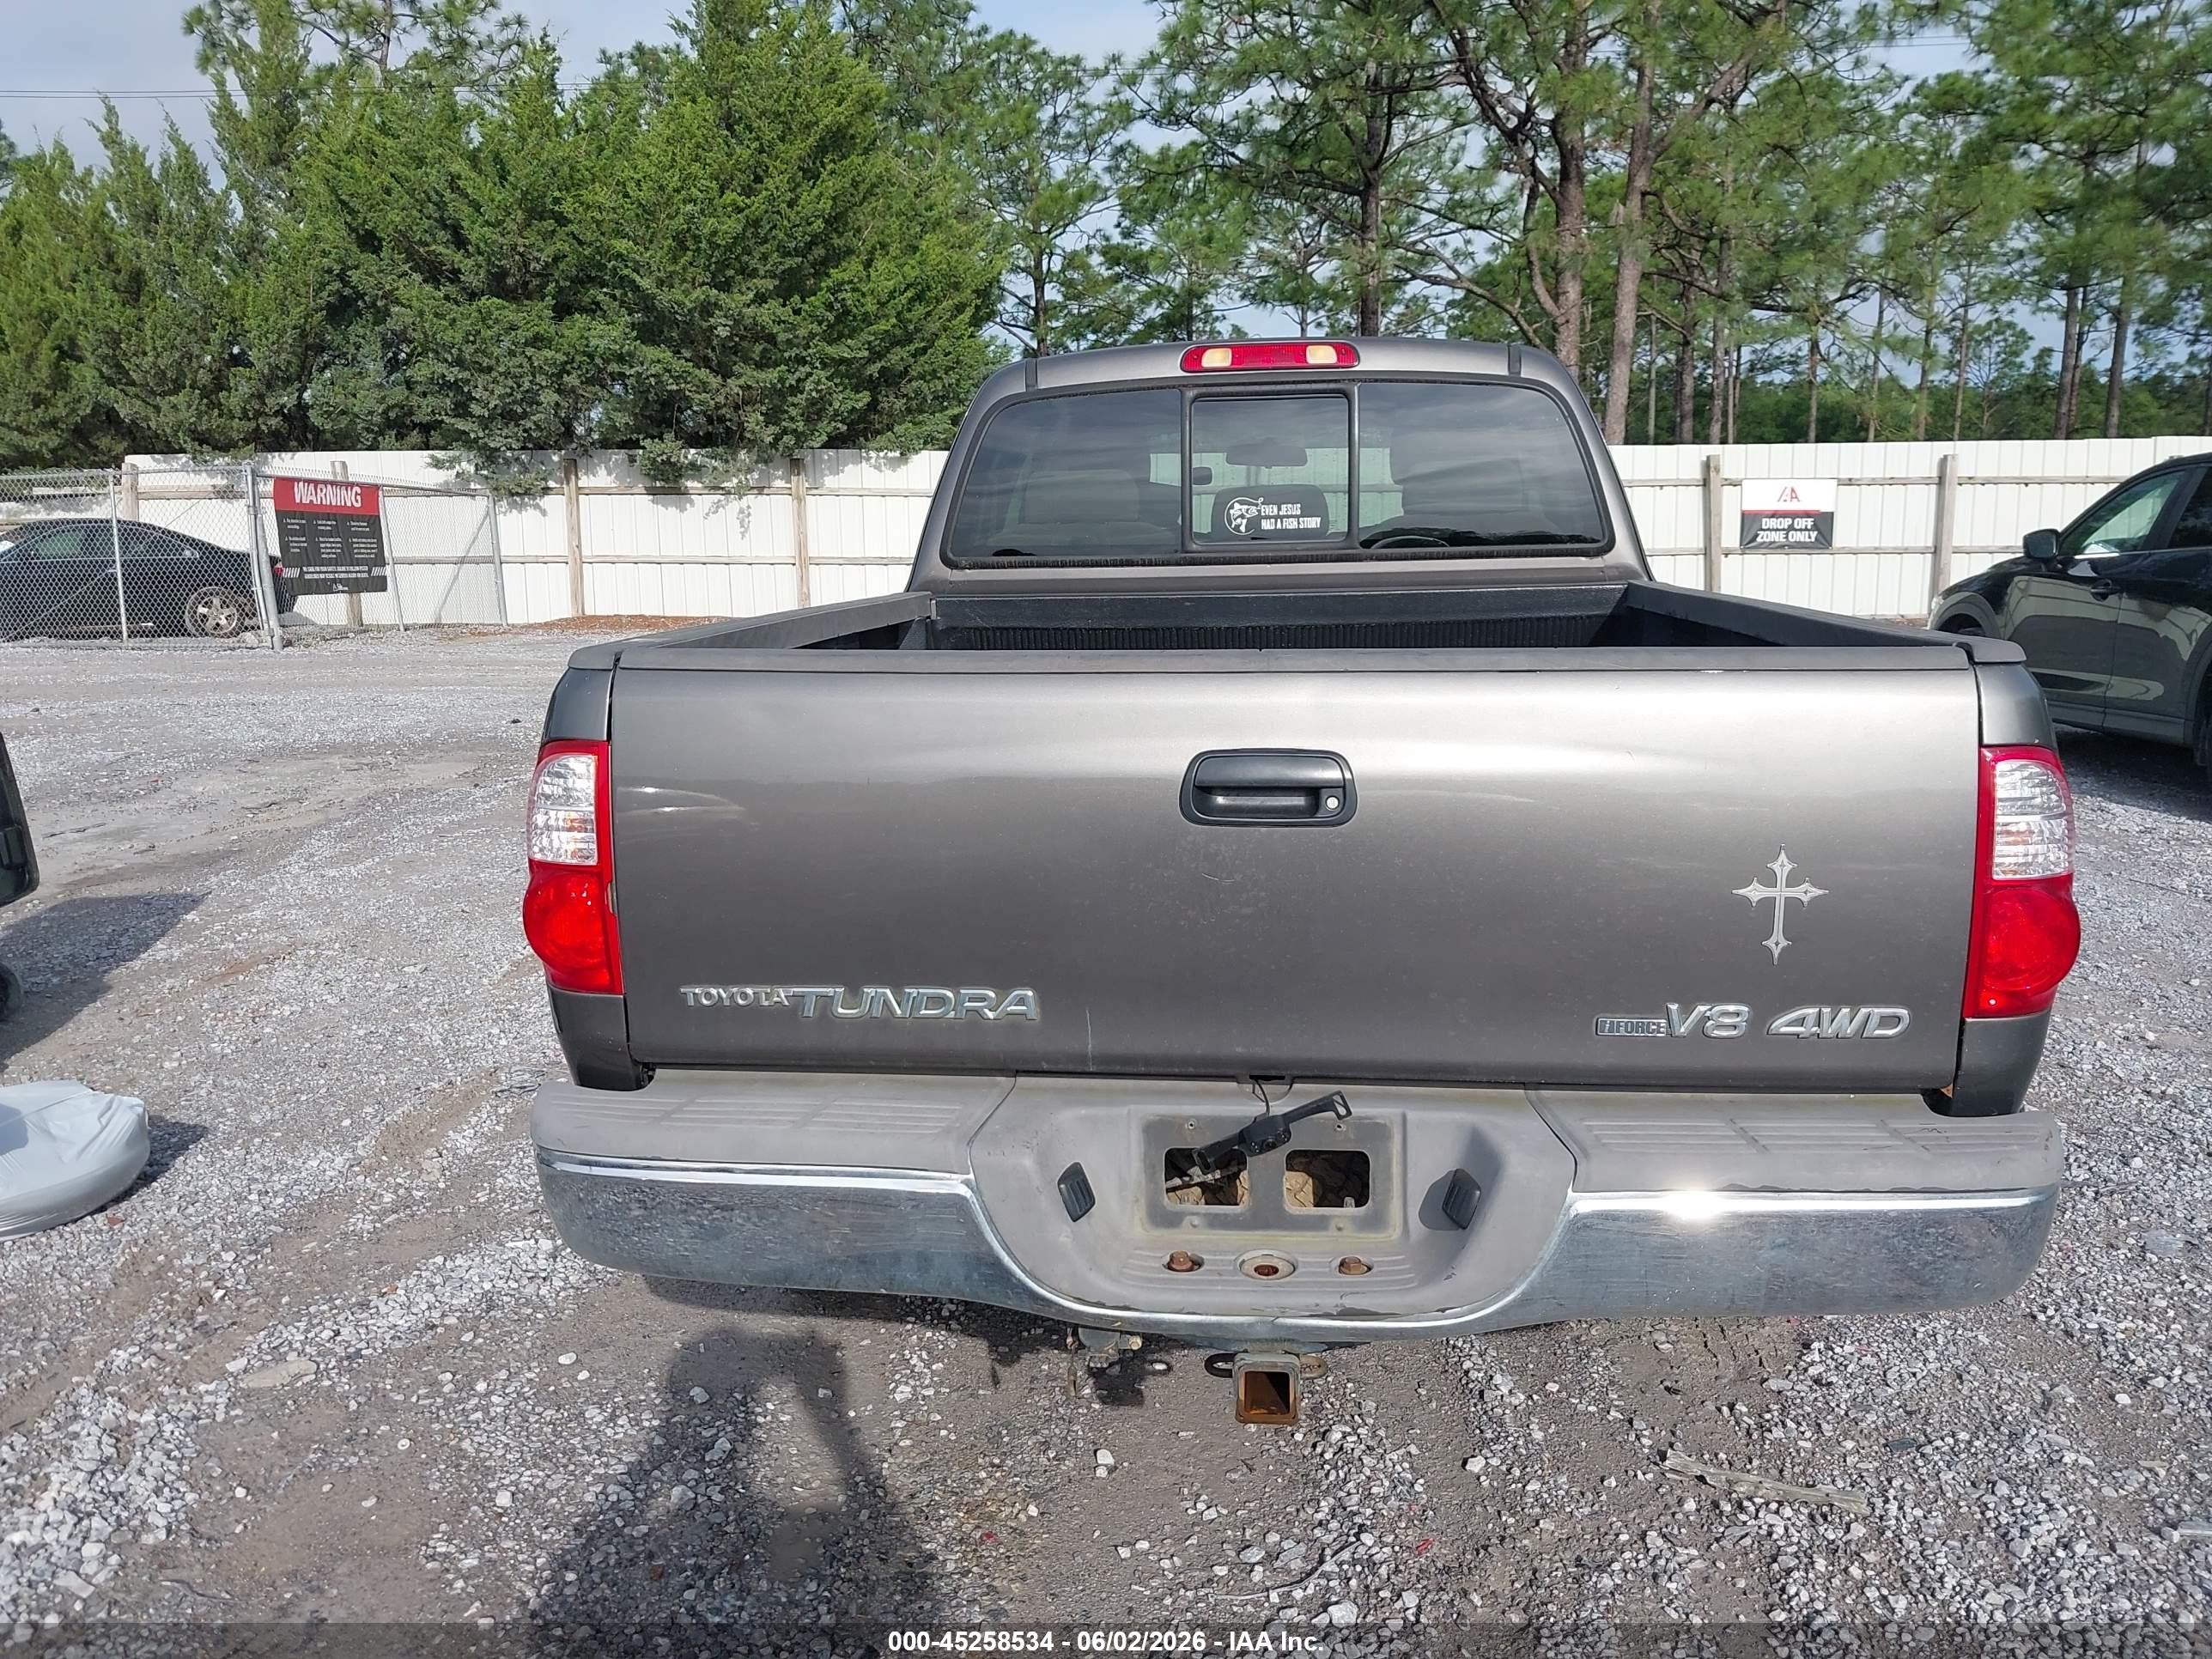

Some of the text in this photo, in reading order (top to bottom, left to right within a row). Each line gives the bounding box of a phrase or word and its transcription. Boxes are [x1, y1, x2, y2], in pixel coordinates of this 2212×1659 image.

[294, 481, 362, 507] WARNING
[1261, 503, 1301, 516] EVEN JESUS
[1261, 517, 1322, 530] HAD A FISH STORY
[1762, 518, 1814, 529] DROP OFF
[1756, 531, 1818, 542] ZONE ONLY
[679, 986, 1038, 1020] TOYOTA TUNDRA
[1665, 1002, 1752, 1039] V8
[1766, 1006, 1911, 1039] 4WD
